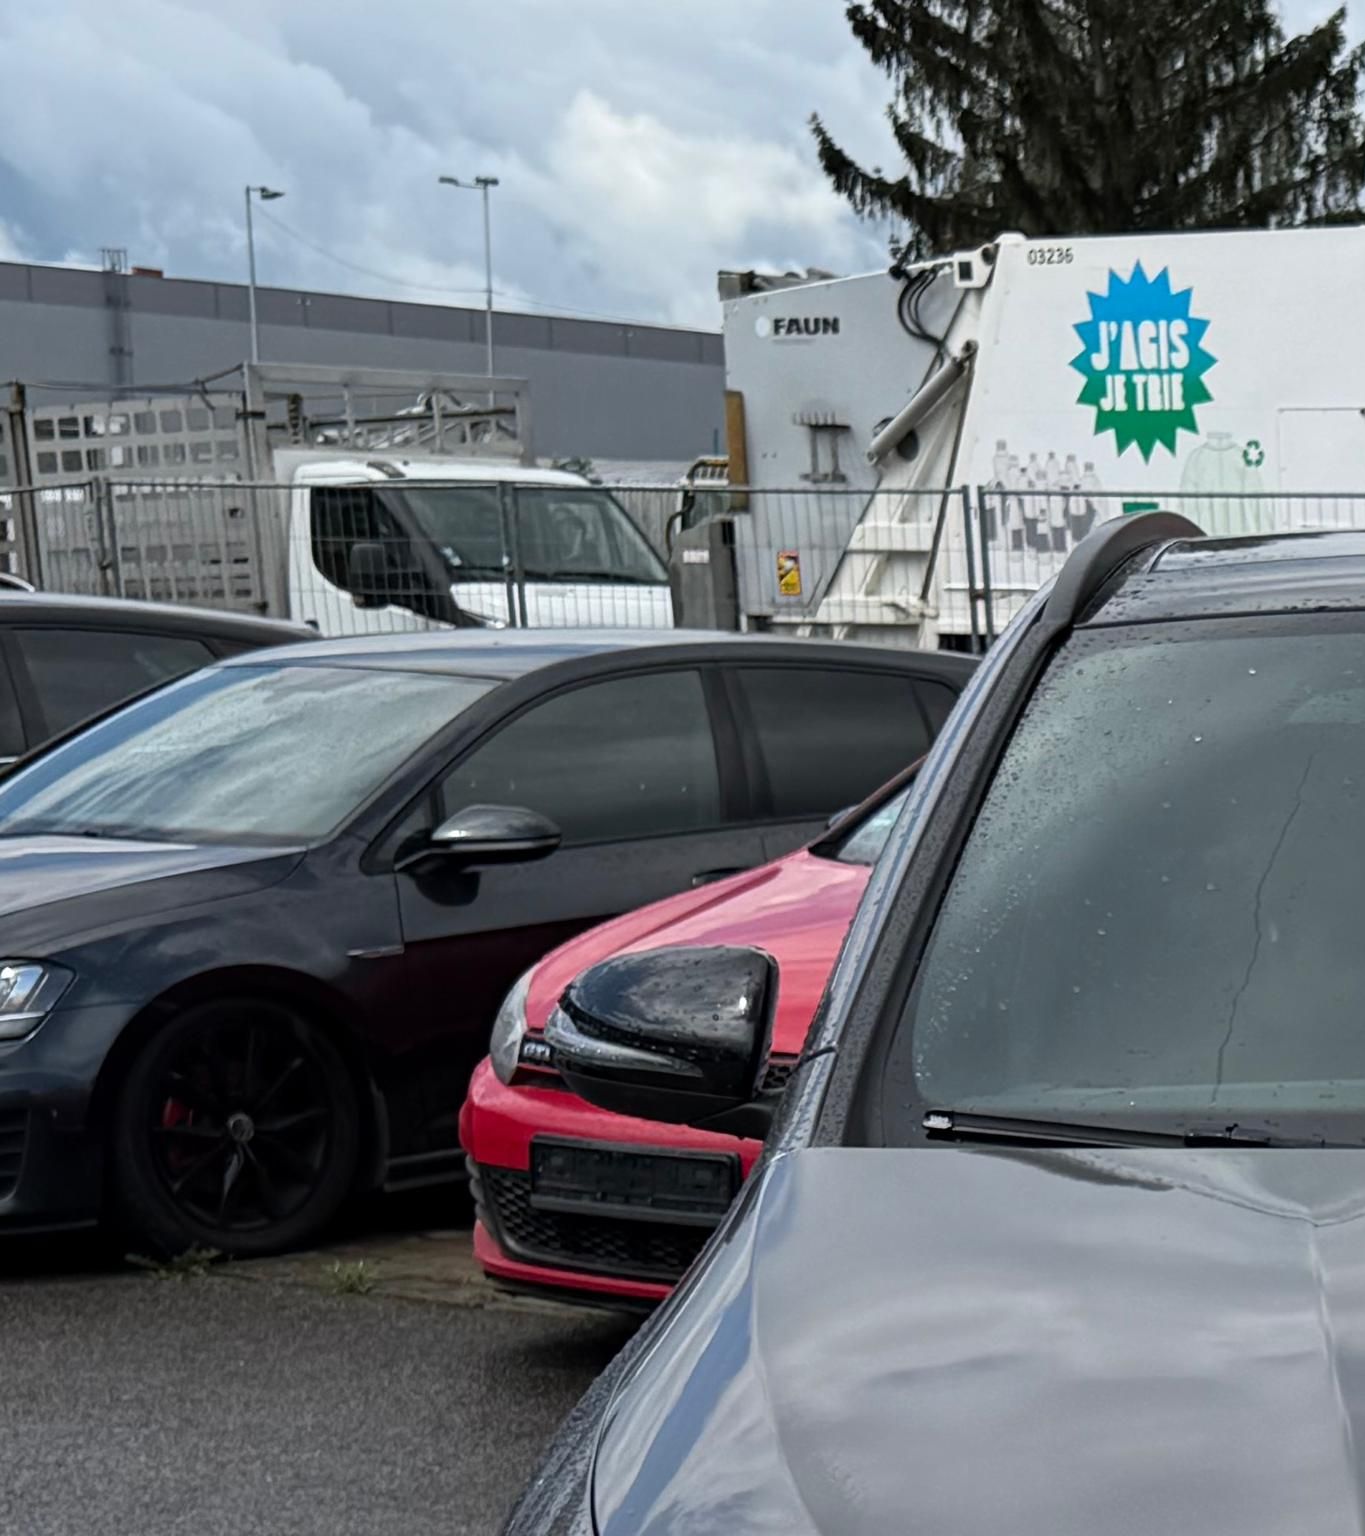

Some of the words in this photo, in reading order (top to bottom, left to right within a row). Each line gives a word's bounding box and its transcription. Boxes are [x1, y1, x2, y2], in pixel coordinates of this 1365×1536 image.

[1027, 248, 1074, 266] 03236
[773, 317, 840, 336] FAUN
[1100, 374, 1128, 412] JE
[1132, 373, 1185, 412] TRIE
